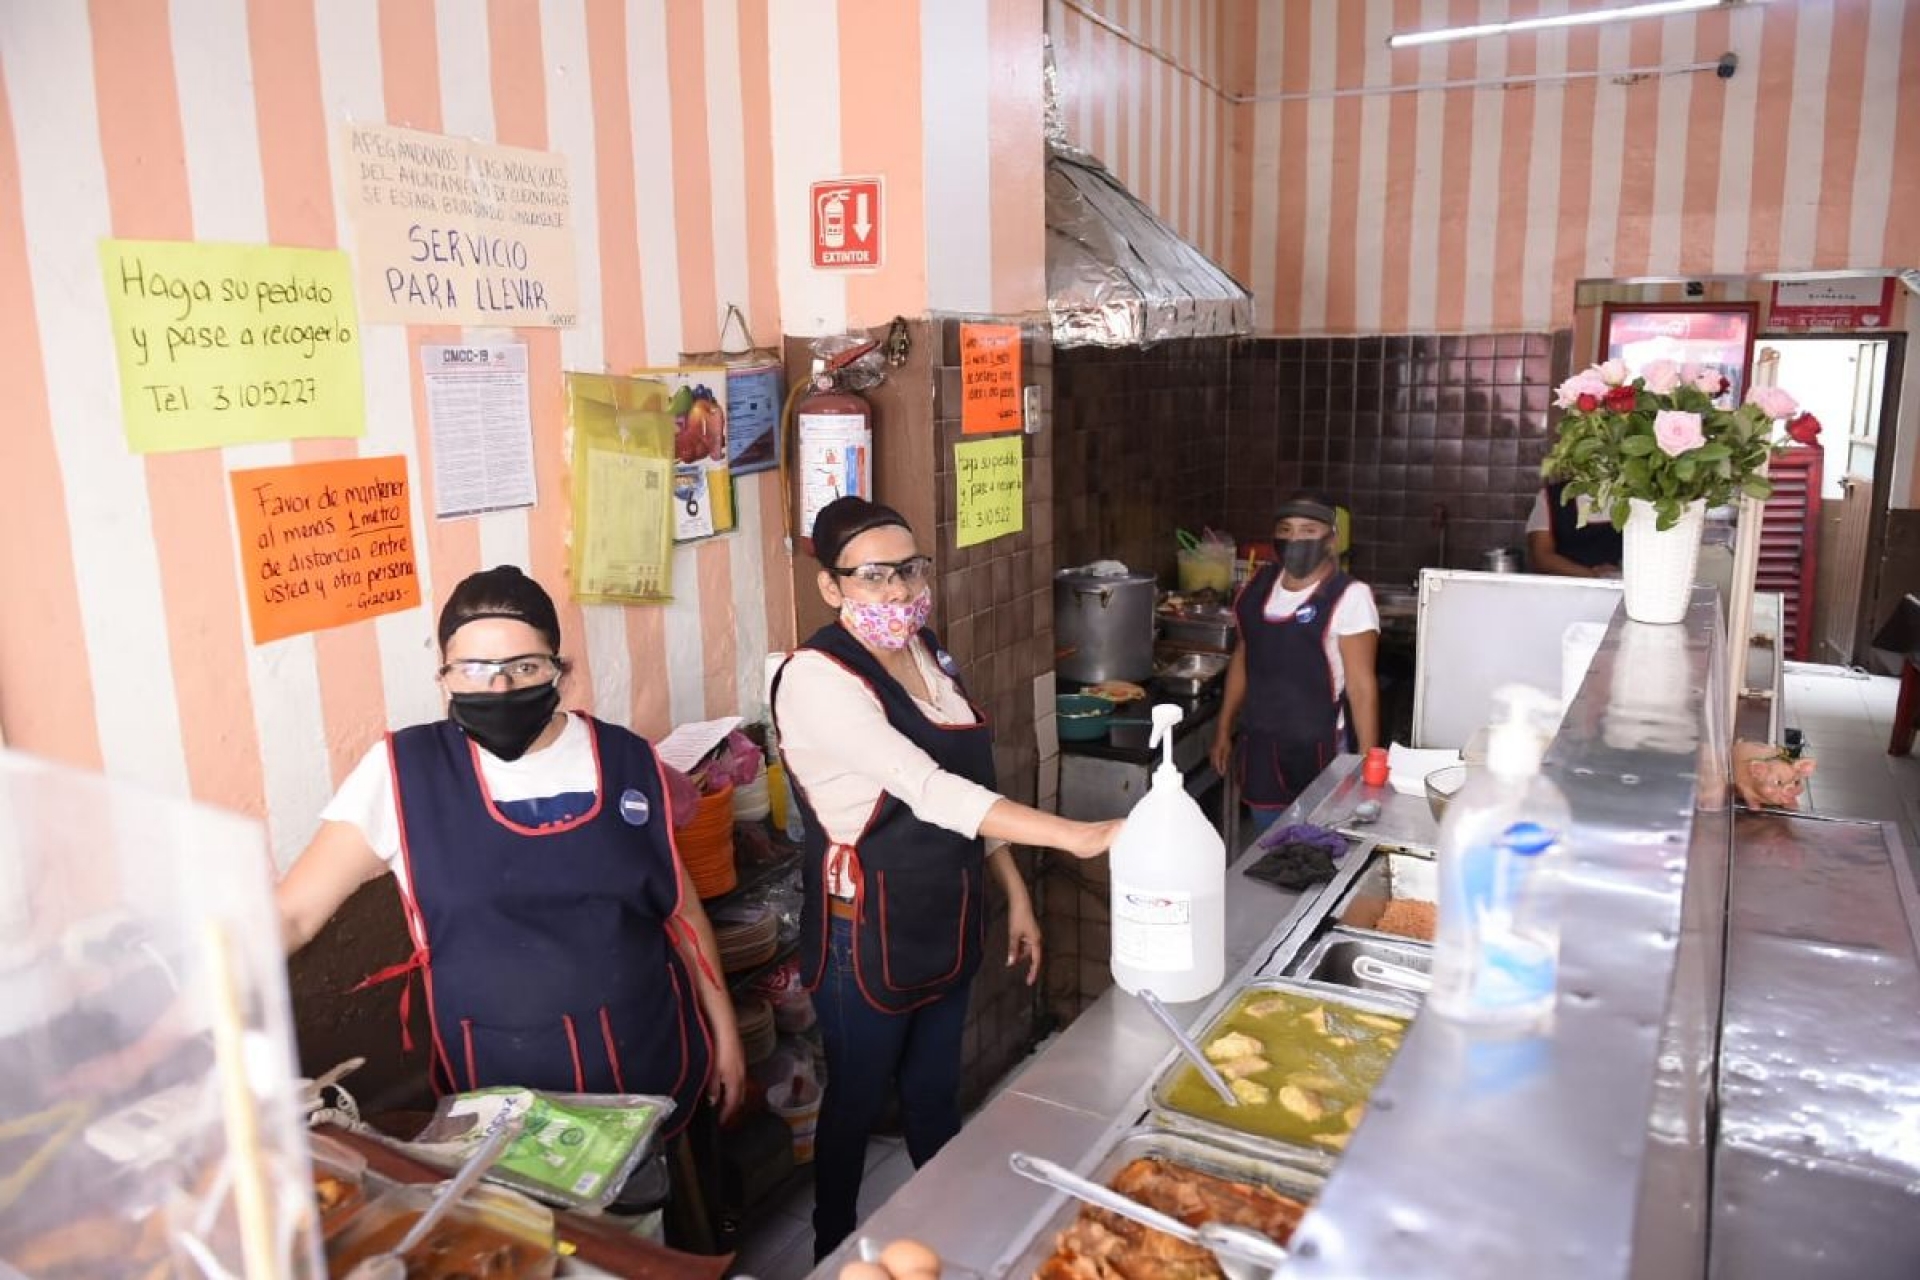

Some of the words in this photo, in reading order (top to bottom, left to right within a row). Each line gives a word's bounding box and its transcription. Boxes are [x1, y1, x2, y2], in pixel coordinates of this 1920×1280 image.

[408, 224, 528, 271] SERVICIO
[120, 256, 211, 321] Haga
[222, 278, 249, 302] su
[256, 275, 332, 313] pedido
[386, 267, 458, 310] PARA
[476, 277, 549, 312] LLEVAR
[131, 327, 148, 365] y
[166, 325, 231, 362] pase
[240, 330, 254, 346] a
[263, 316, 352, 359] recogerlo
[142, 384, 190, 413] Tel
[253, 482, 311, 517] Favor
[317, 485, 338, 510] de
[345, 477, 404, 505] mantener
[258, 523, 275, 550] al
[282, 517, 335, 545] menos
[348, 509, 359, 532] 1
[361, 506, 400, 526] metro
[261, 558, 281, 580] de
[288, 546, 361, 573] distancia
[370, 533, 407, 558] entre
[264, 579, 310, 604] usted
[315, 580, 326, 600] y
[333, 566, 361, 590] otra
[368, 560, 415, 593] persona
